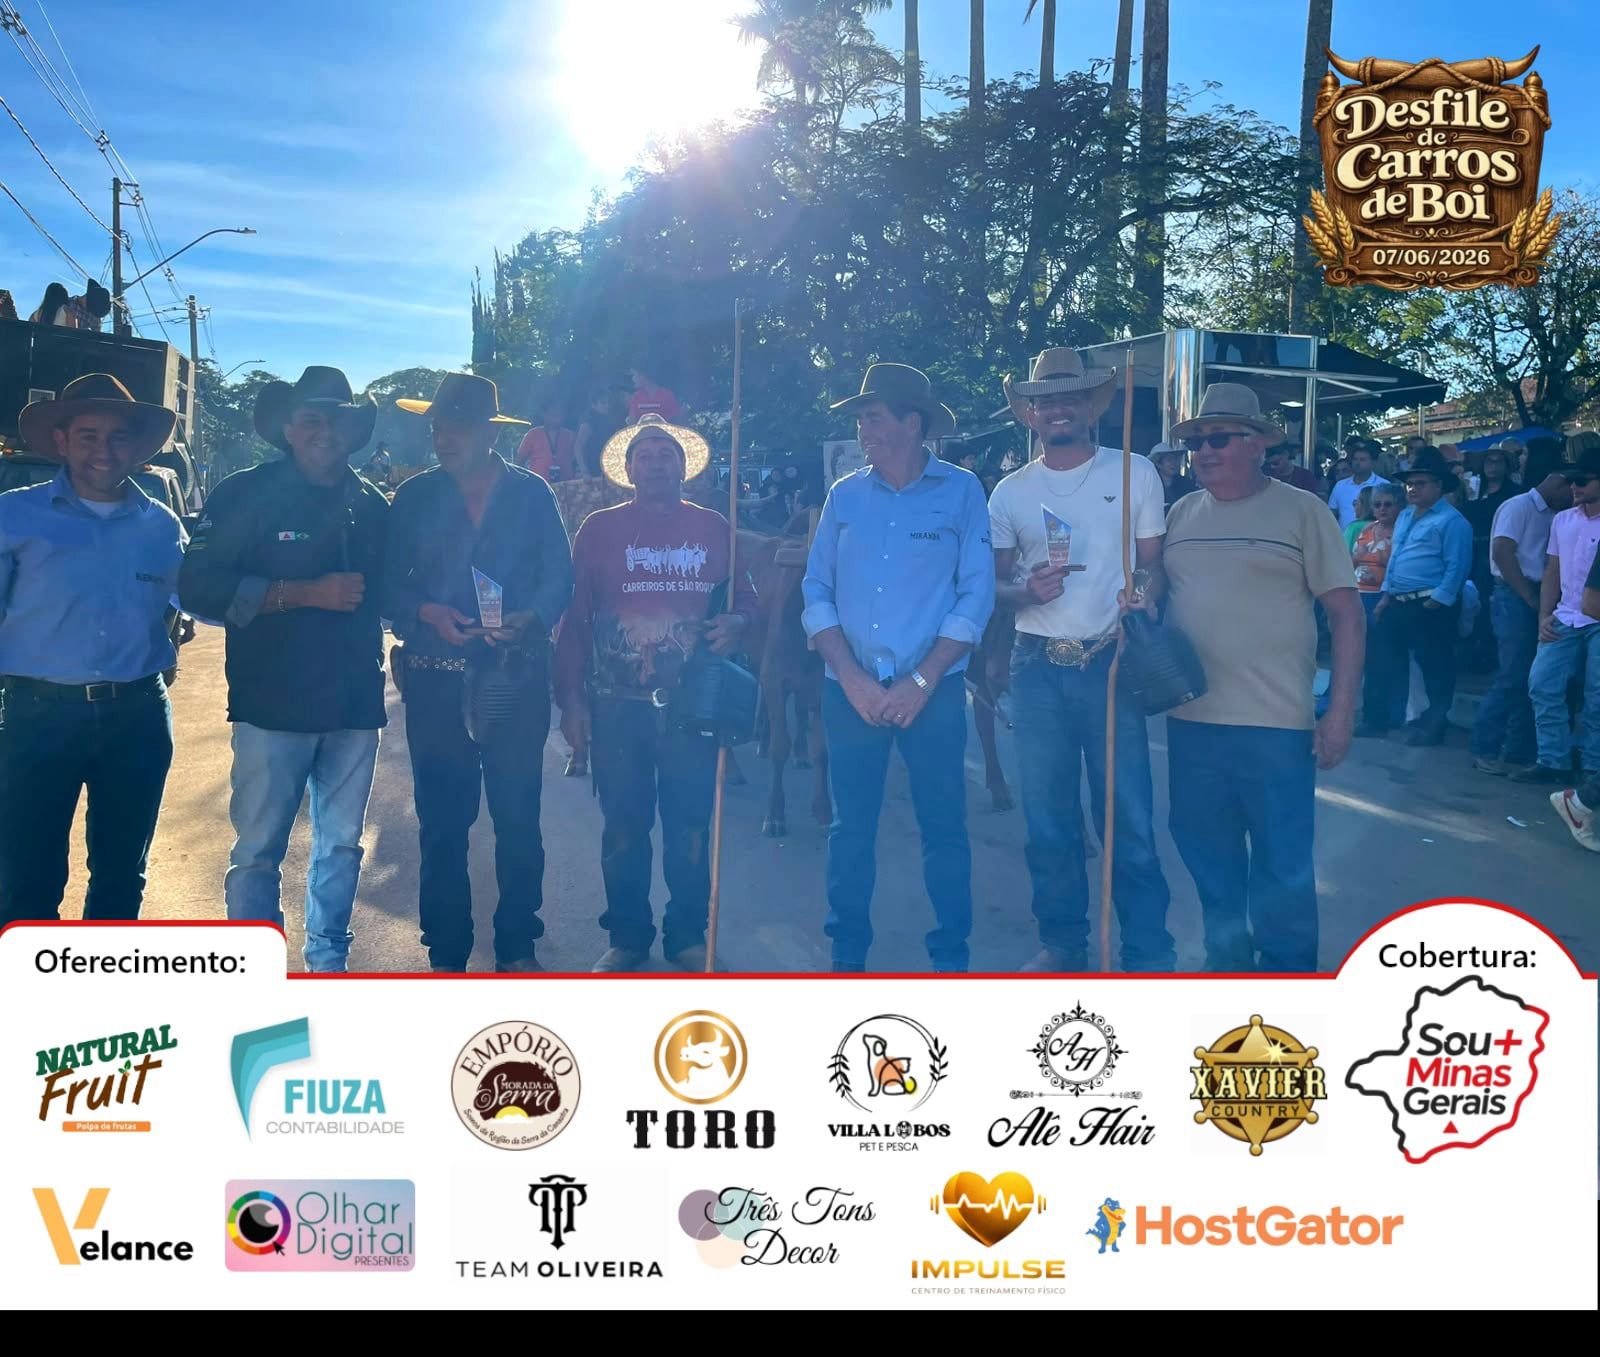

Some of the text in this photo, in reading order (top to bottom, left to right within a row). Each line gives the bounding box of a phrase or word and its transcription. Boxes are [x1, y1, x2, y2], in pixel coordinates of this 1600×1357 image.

[622, 581, 665, 593] CARREIROS
[666, 581, 677, 592] DE
[678, 579, 694, 592] SÃO
